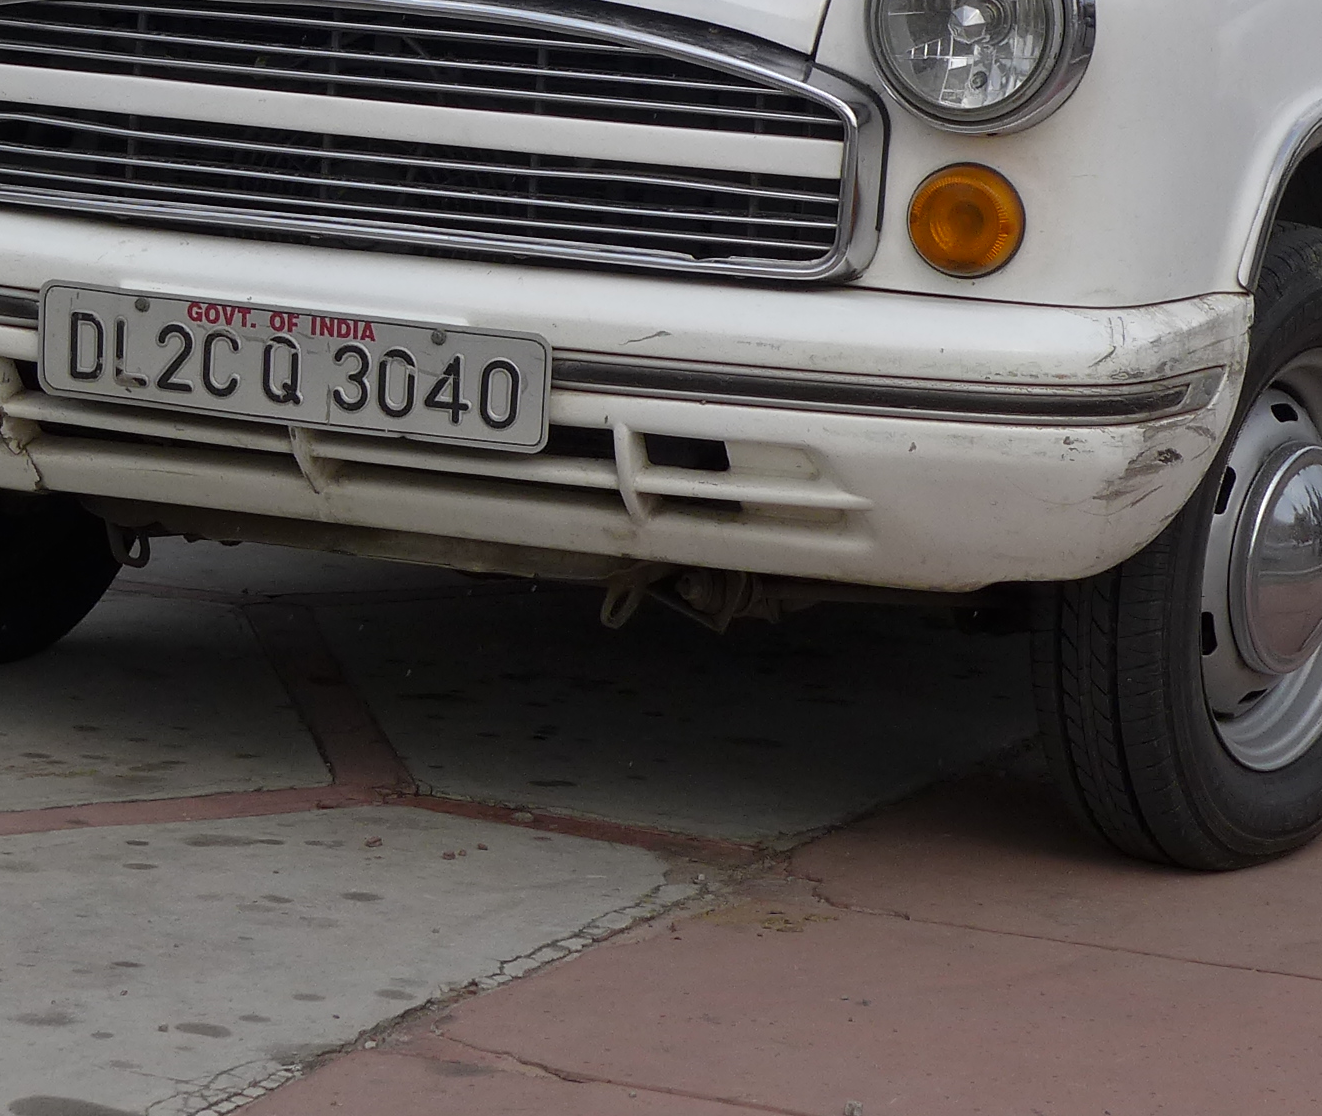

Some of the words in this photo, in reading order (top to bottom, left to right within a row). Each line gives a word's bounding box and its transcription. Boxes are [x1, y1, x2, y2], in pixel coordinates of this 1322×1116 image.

[186, 301, 257, 329] GOVT.
[269, 310, 300, 334] OF
[309, 315, 376, 343] INDIA
[261, 334, 302, 406] Q
[331, 342, 522, 430] 3040
